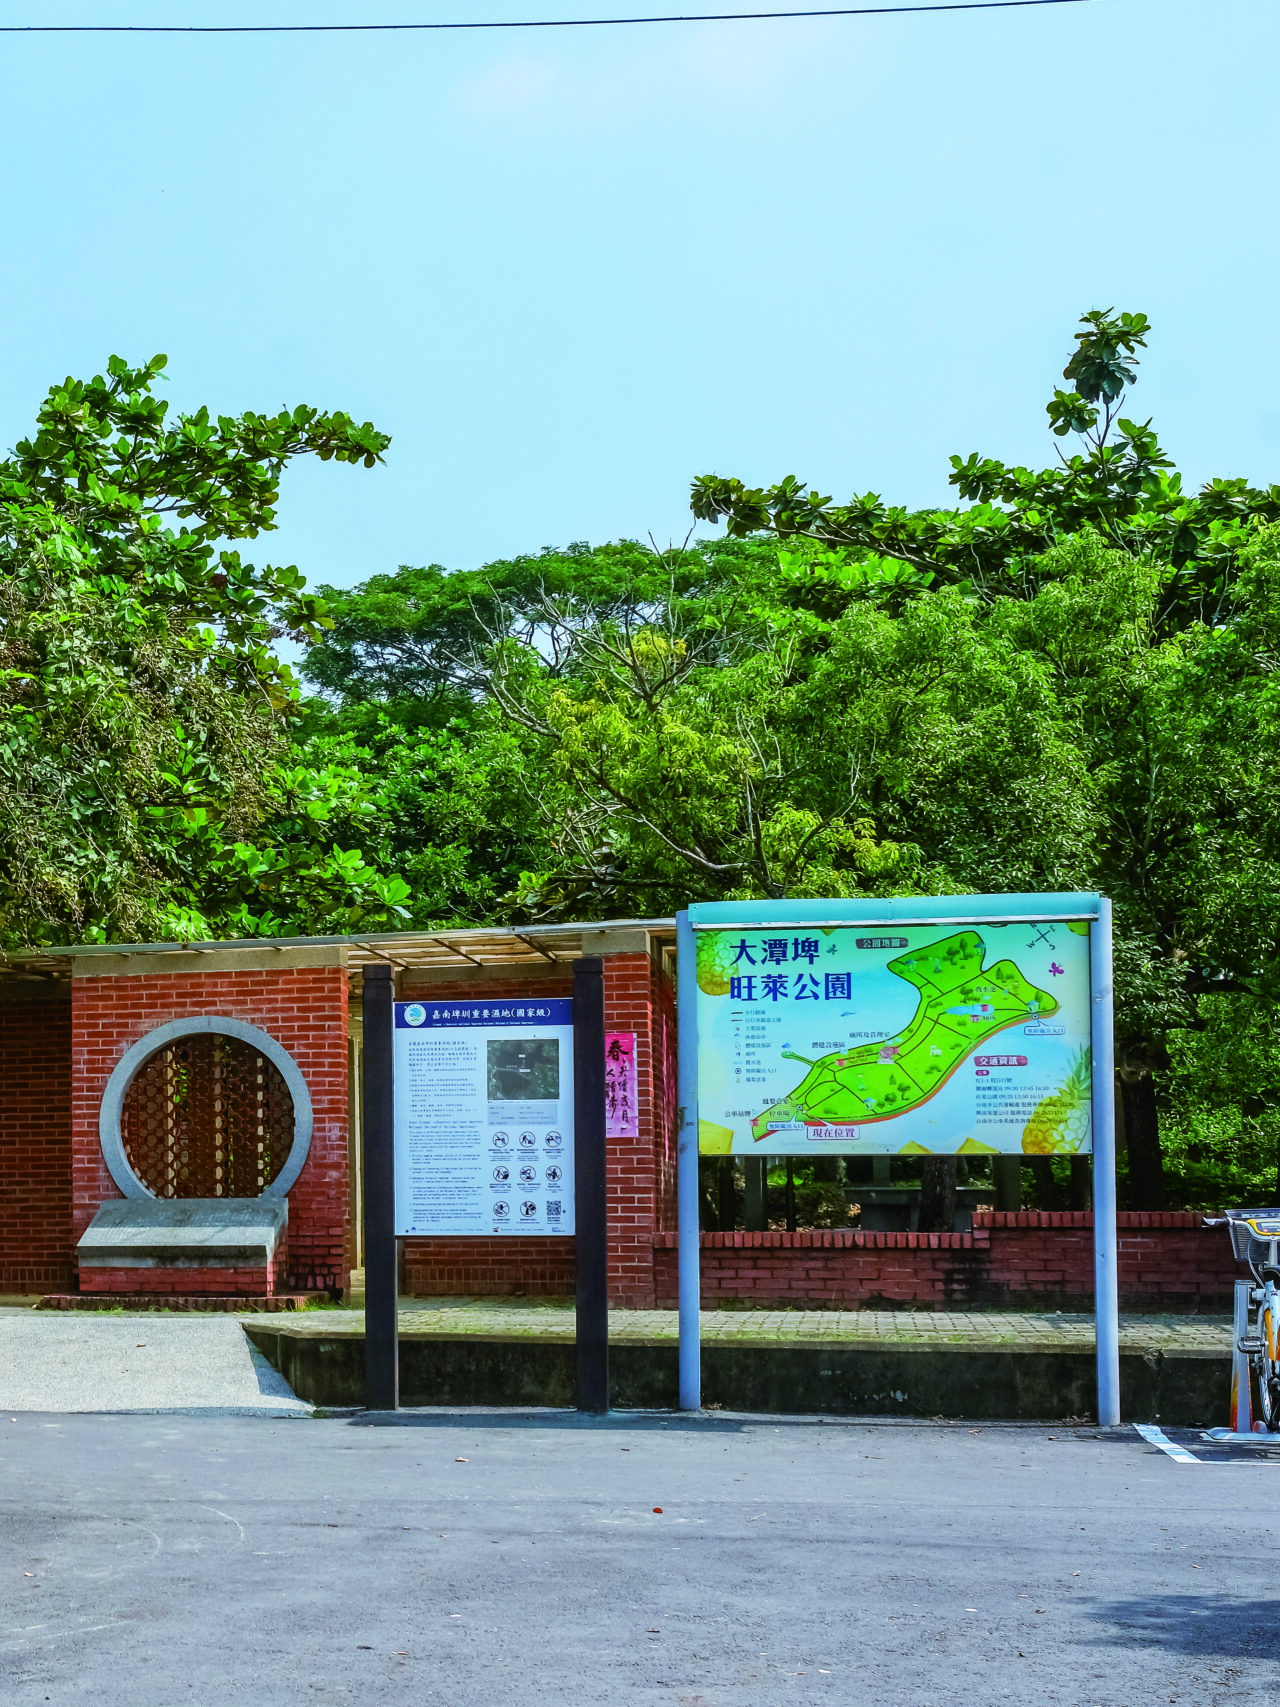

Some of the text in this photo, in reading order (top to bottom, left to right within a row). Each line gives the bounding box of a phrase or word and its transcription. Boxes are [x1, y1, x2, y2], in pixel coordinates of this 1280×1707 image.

[729, 936, 820, 966] 大潭埤
[729, 971, 852, 1001] 旺萊公園
[432, 1007, 552, 1020] 嘉南埤圳重要濕地(國家級)
[607, 1039, 629, 1061] 春
[979, 1056, 1018, 1066] 交通資訊
[812, 1128, 855, 1138] 現在位置
